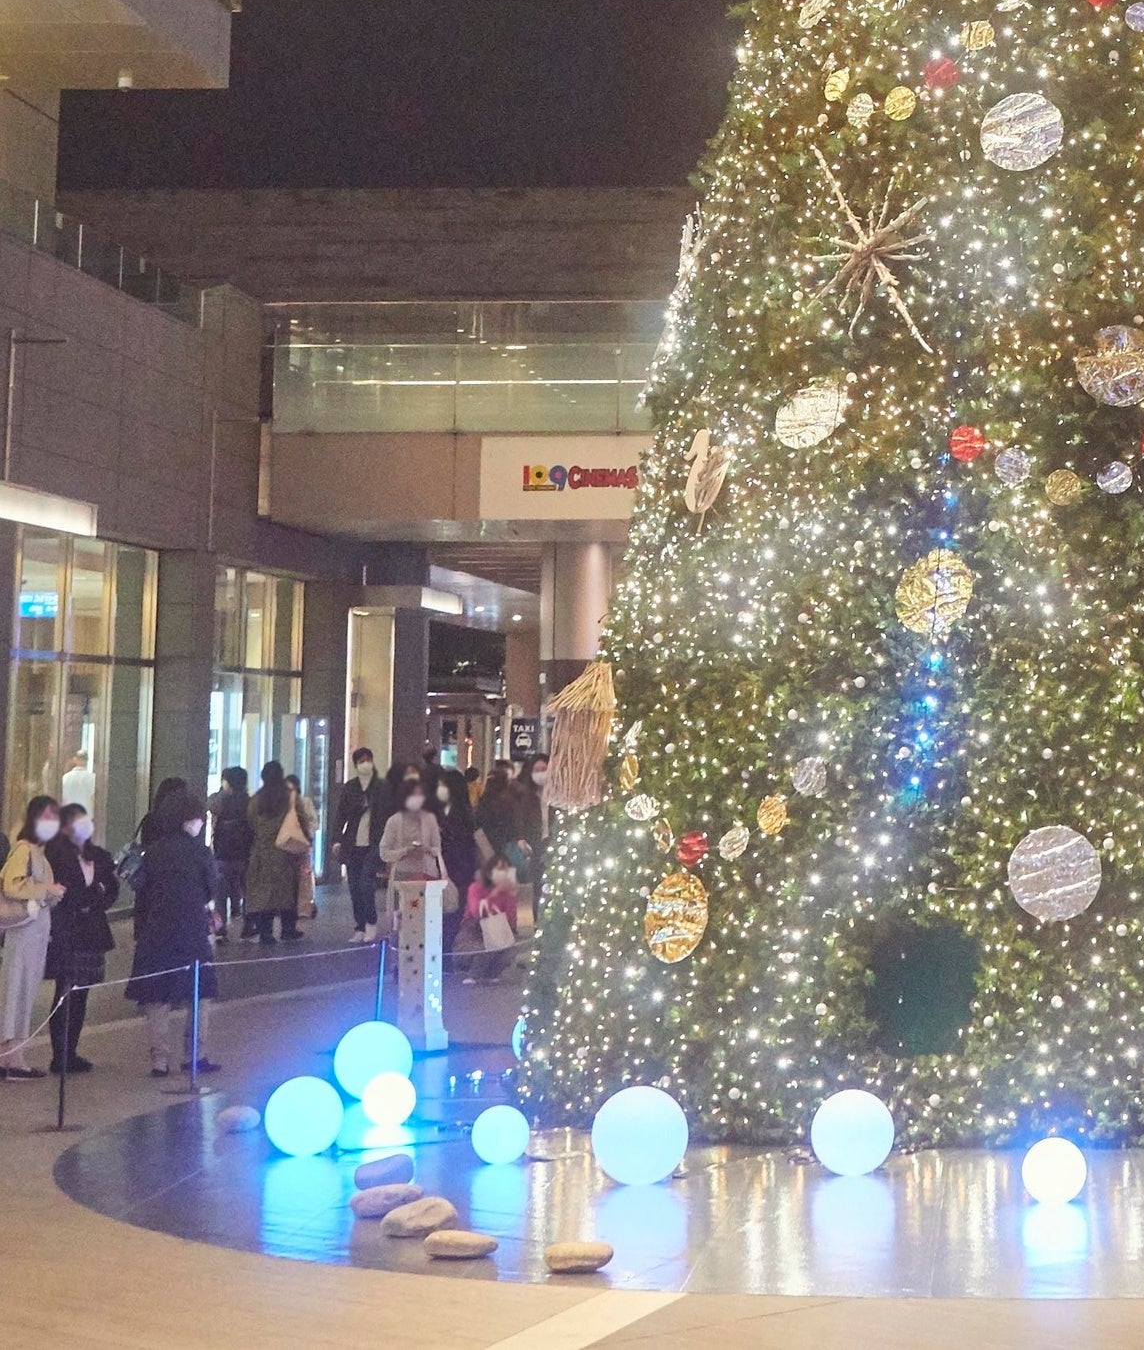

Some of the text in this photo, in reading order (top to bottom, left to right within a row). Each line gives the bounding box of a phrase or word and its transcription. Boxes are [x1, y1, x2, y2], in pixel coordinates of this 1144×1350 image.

[523, 465, 639, 491] 109 CINEMAS
[513, 725, 535, 733] TAXI
